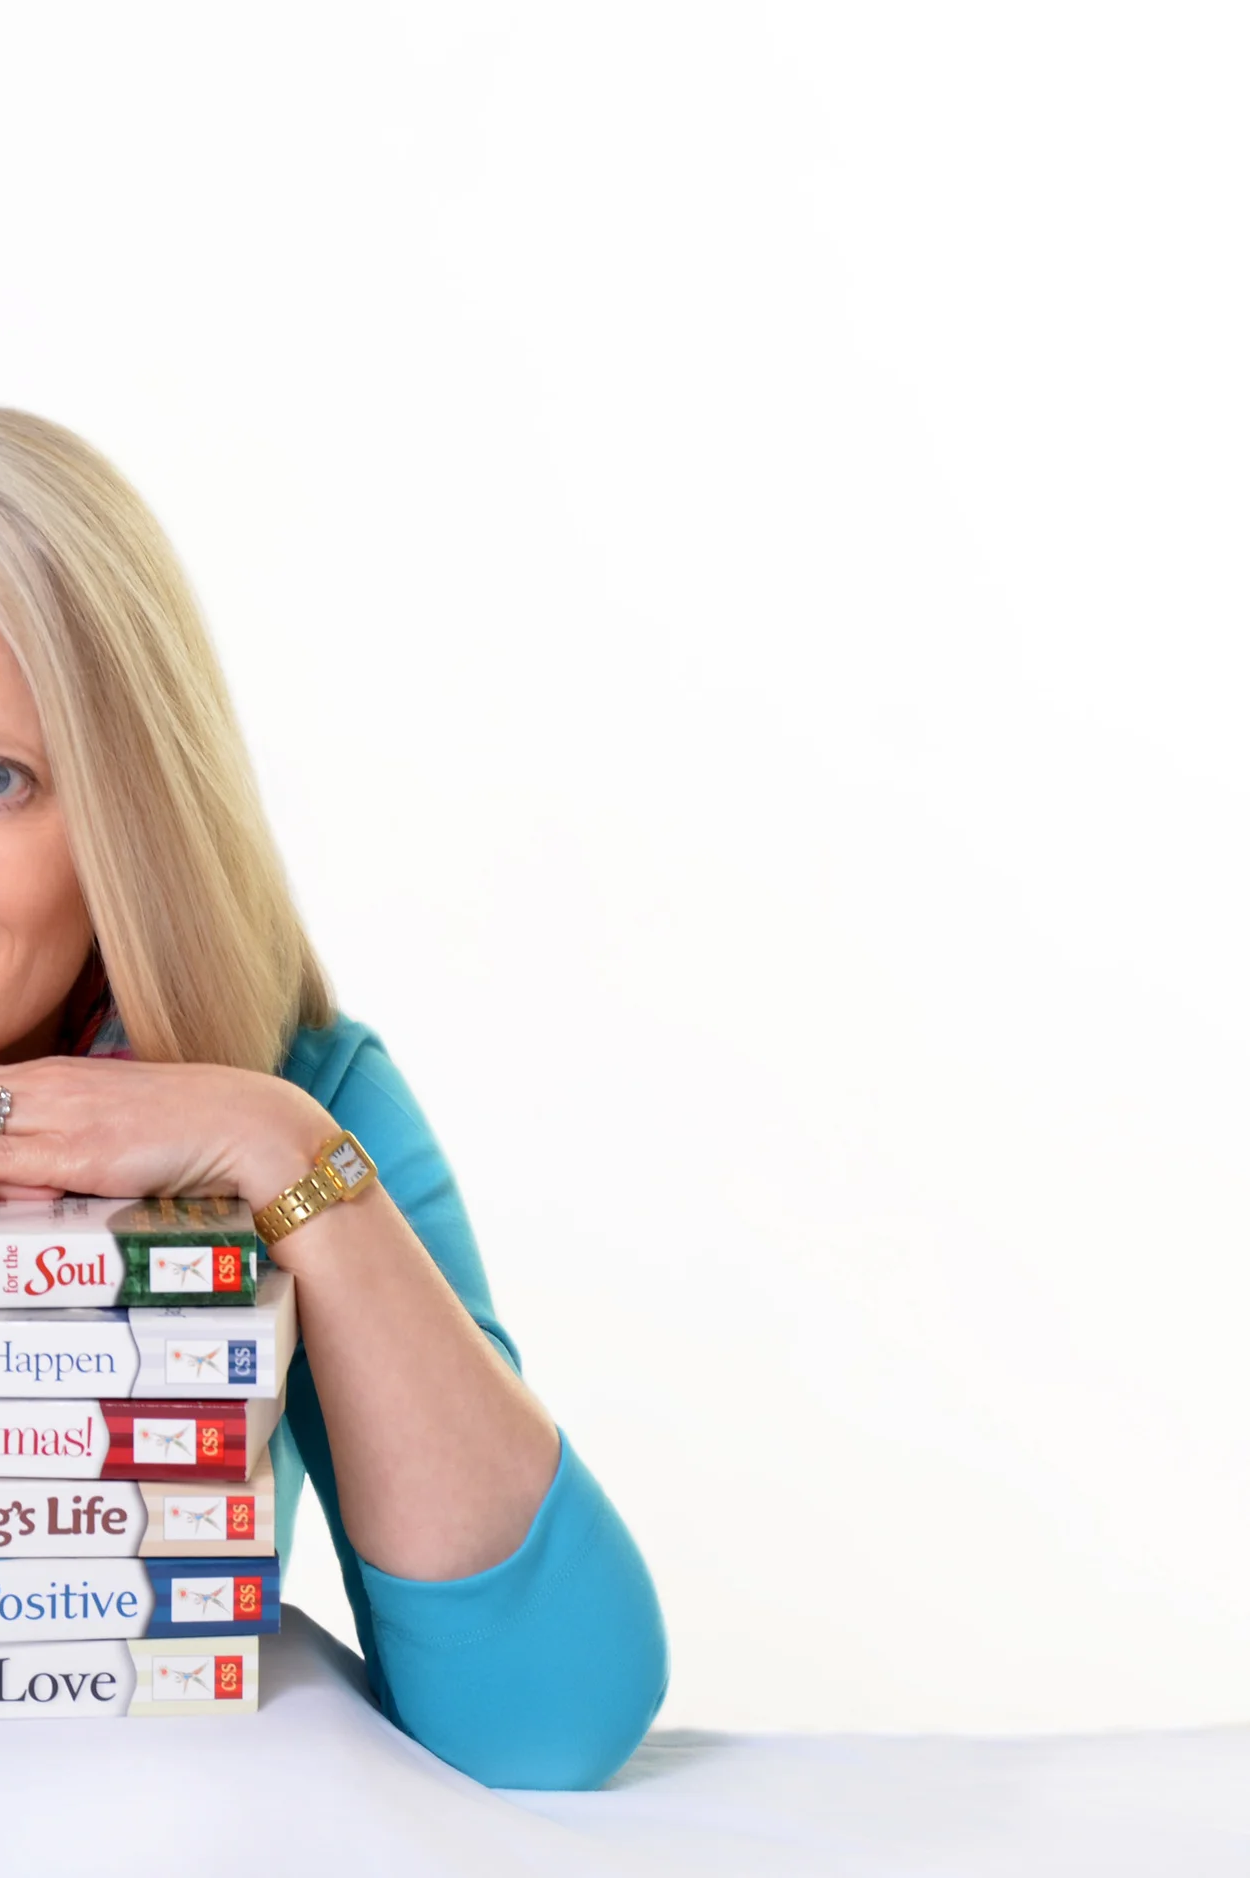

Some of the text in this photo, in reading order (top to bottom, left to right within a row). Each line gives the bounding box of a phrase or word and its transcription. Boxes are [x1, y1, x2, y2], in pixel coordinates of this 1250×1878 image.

[2, 1245, 18, 1269] the
[24, 1246, 106, 1296] Soul
[218, 1254, 236, 1284] CSS
[2, 1272, 18, 1294] for
[235, 1347, 251, 1376] CSS
[202, 1427, 219, 1456] CSS
[47, 1495, 128, 1536] Life
[233, 1503, 249, 1532] CSS
[240, 1584, 256, 1612] CSS
[221, 1663, 238, 1691] CSS
